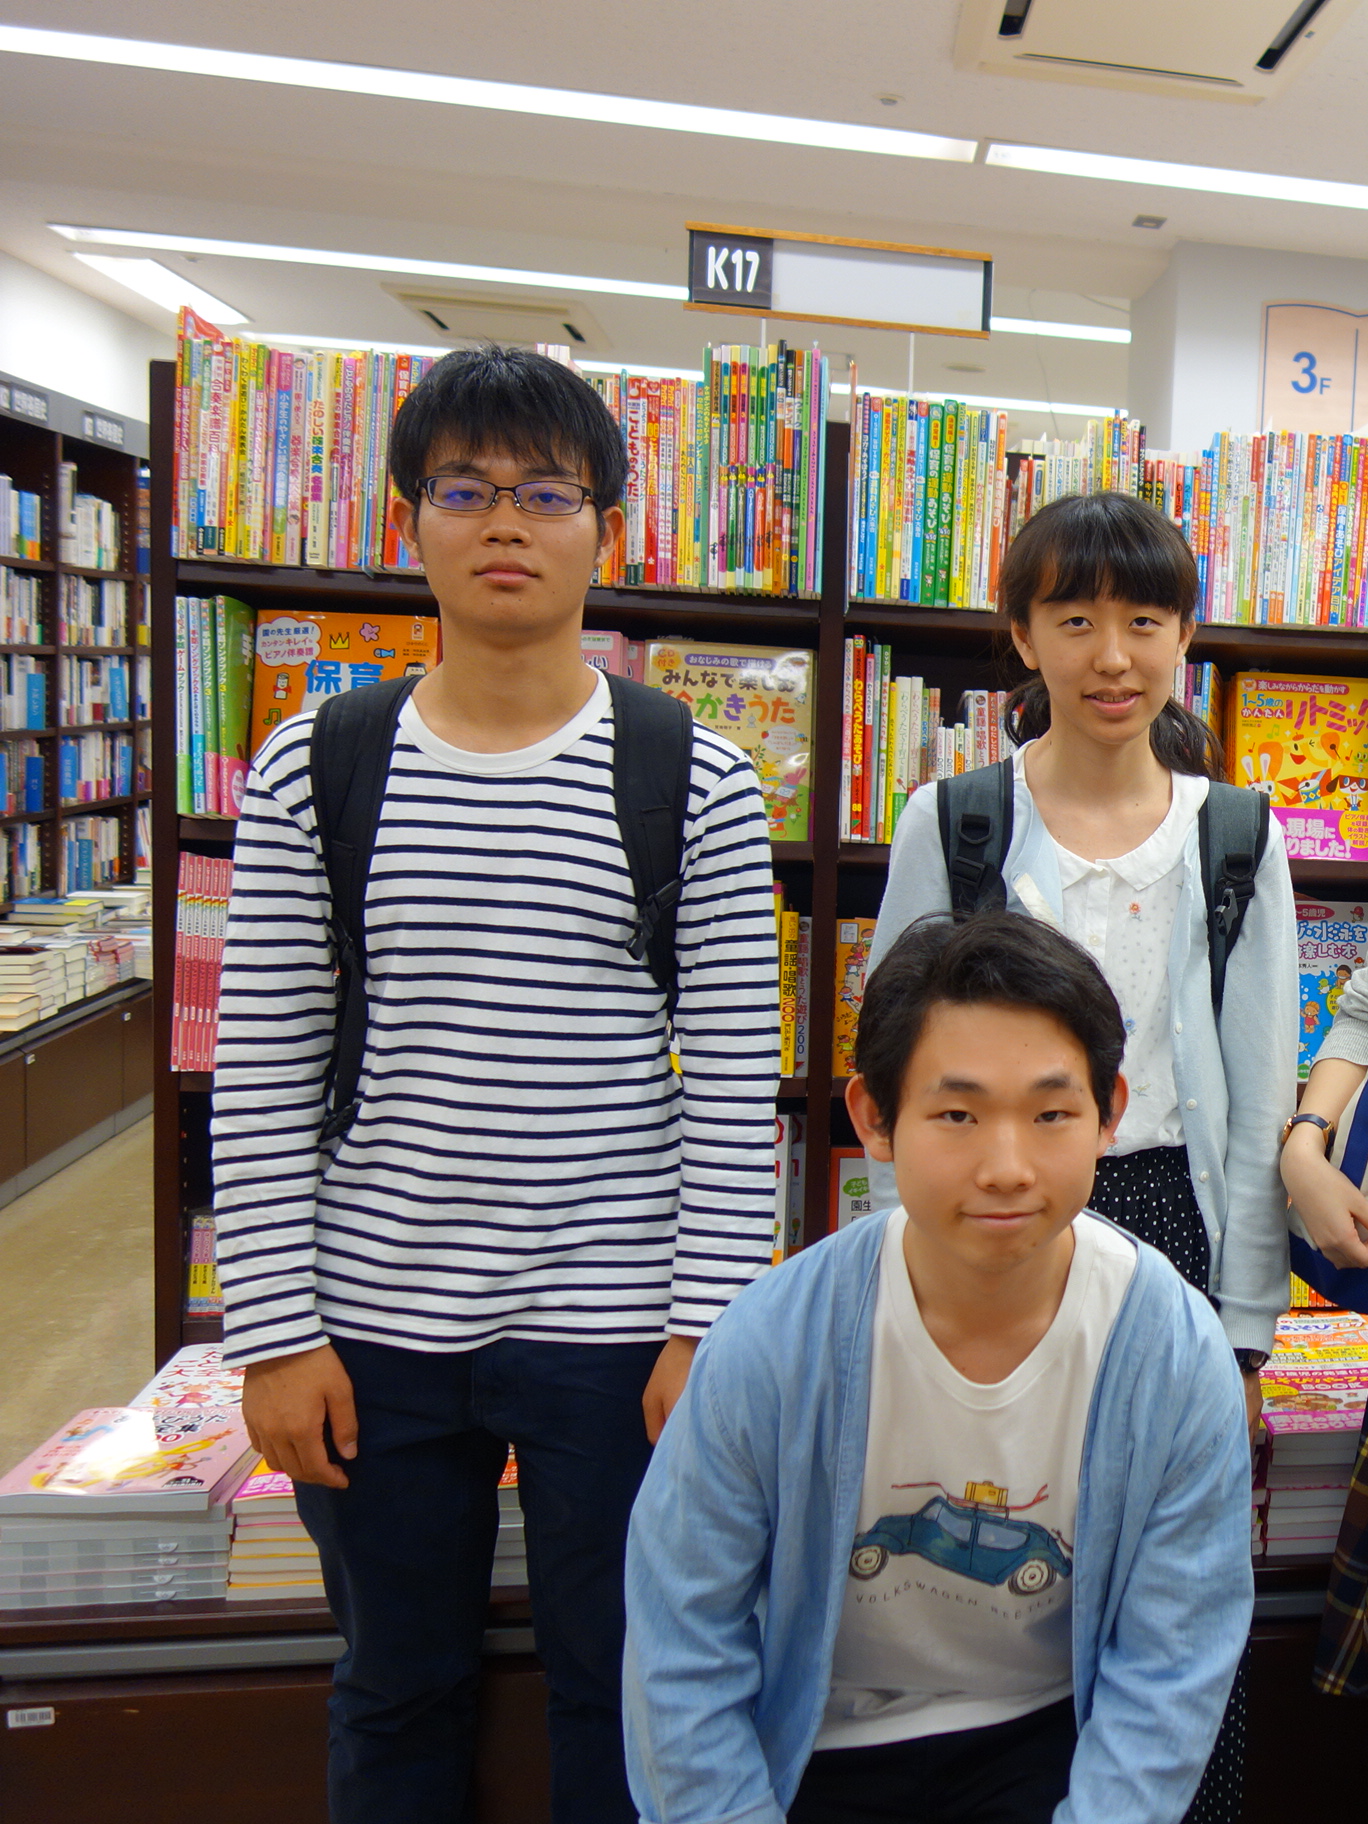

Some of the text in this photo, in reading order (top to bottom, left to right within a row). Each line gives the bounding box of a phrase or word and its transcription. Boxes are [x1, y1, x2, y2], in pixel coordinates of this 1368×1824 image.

[707, 246, 760, 292] K17
[1291, 351, 1332, 394] 3F
[662, 669, 795, 693] みんなで楽しむ
[1258, 680, 1347, 694] 楽しみながらからだを動かす
[1241, 708, 1285, 718] かんたん
[1301, 1382, 1364, 1390] BOOK
[856, 1579, 978, 1607] VOLKSWAGEN
